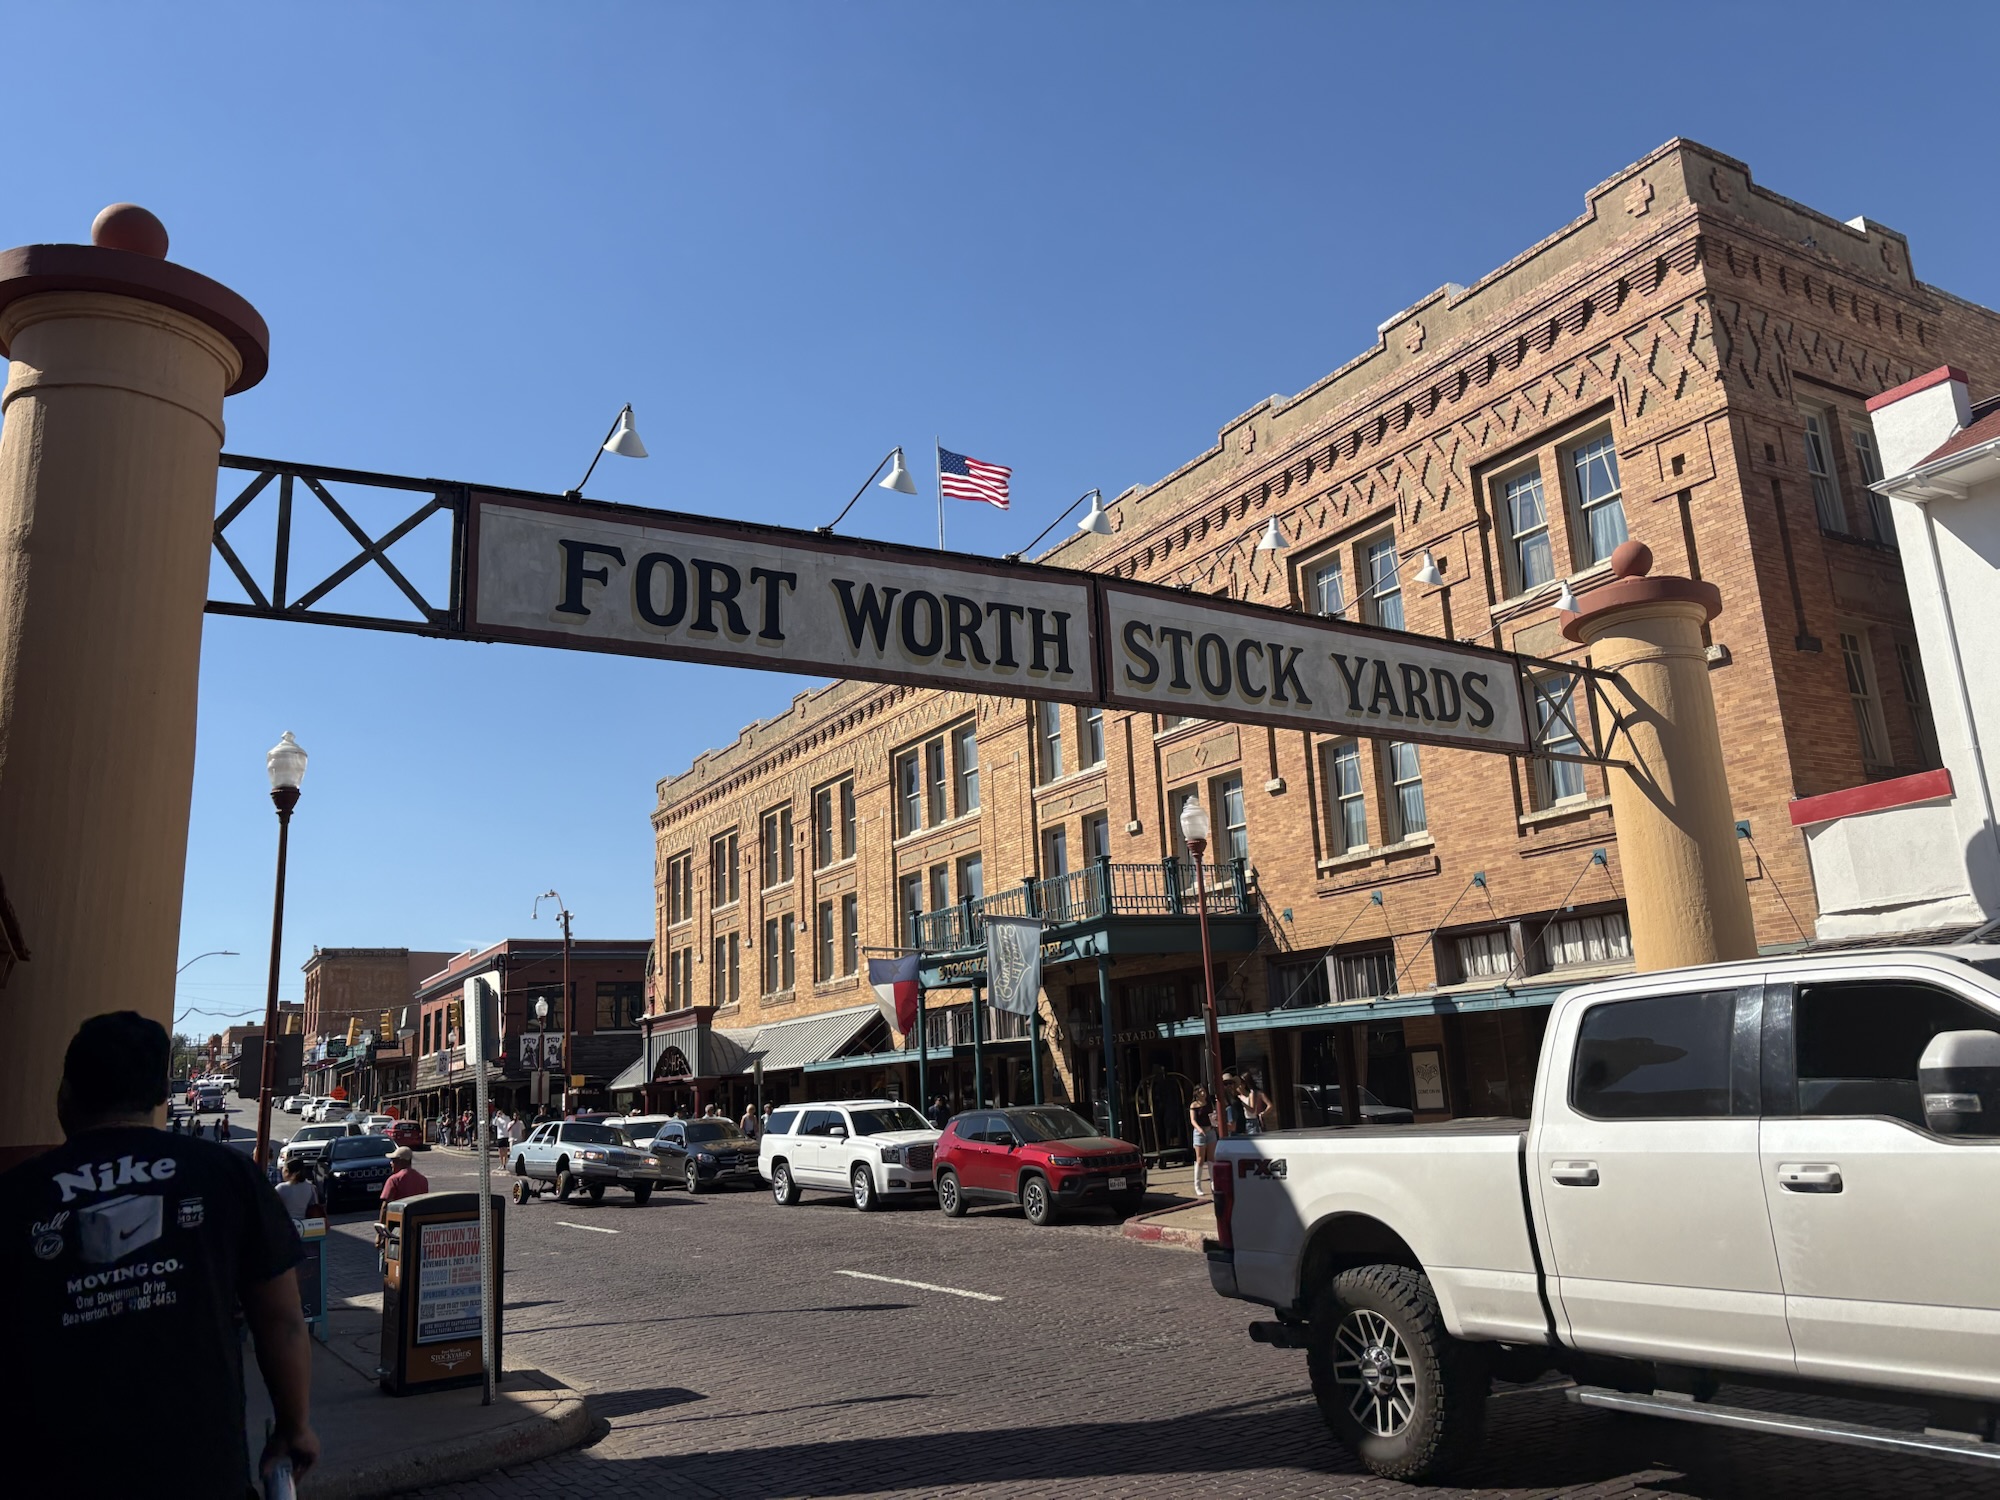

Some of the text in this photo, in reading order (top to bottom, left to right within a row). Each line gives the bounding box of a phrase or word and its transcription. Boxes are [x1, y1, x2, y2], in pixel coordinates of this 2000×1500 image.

[549, 538, 1075, 677] FORT WORTH
[1121, 620, 1495, 731] STOCK YARDS
[938, 958, 988, 980] STOCKYA
[1088, 1030, 1156, 1045] STCKYARD
[53, 1155, 177, 1203] Nike
[1238, 1158, 1287, 1178] FX4
[31, 1210, 70, 1236] Call
[423, 1228, 465, 1244] COWTOWN
[422, 1240, 480, 1260] THROWDOW
[66, 1258, 184, 1294] MOVING CO.
[75, 1296, 94, 1309] One
[143, 1280, 167, 1295] Drive
[430, 1349, 472, 1362] STOCKYARDS
